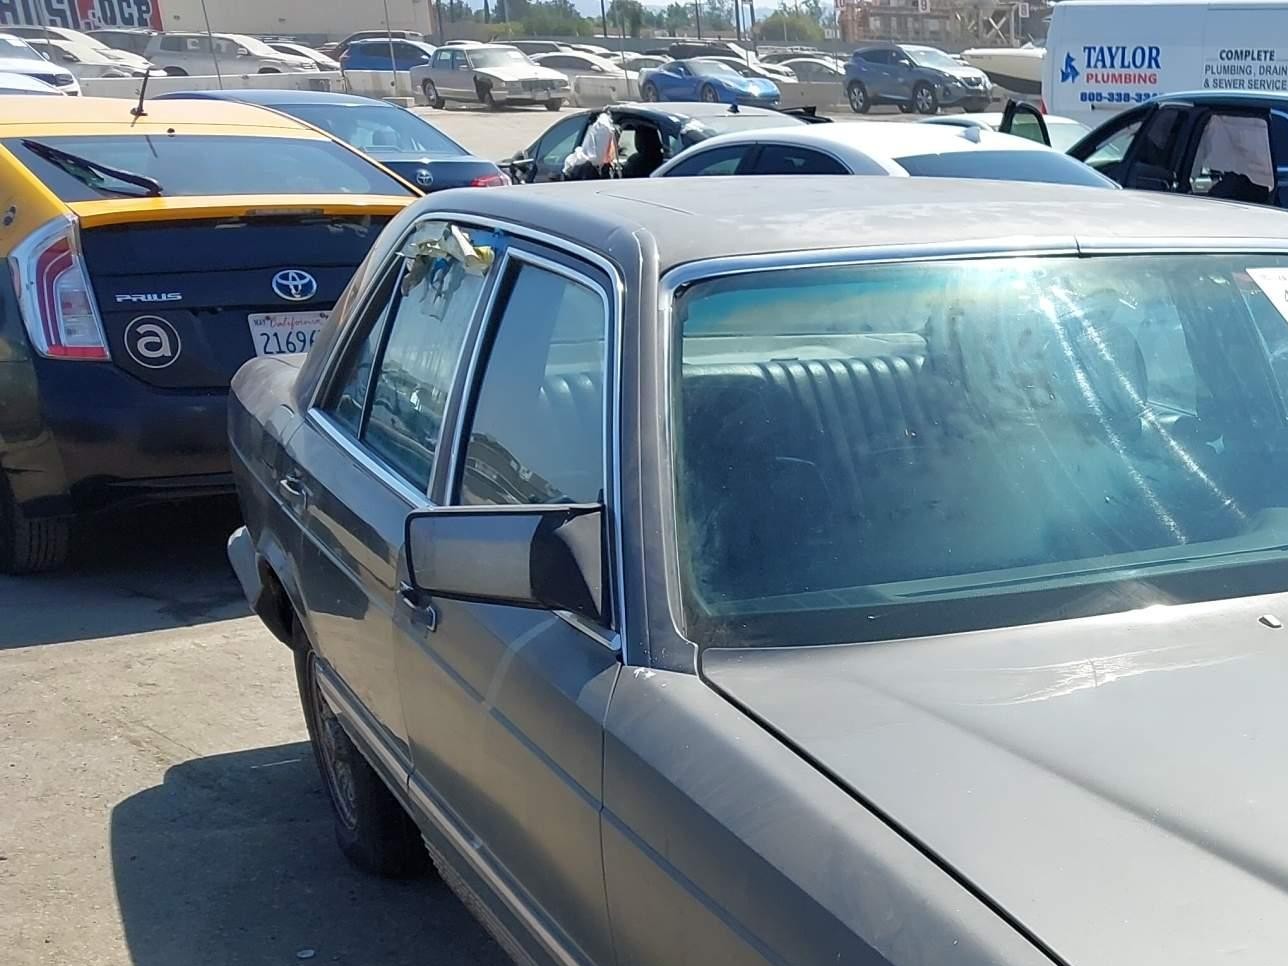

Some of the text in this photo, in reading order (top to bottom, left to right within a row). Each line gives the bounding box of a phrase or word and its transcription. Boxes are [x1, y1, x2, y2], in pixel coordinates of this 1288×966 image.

[1083, 46, 1161, 70] TAYLOR
[1219, 49, 1275, 61] COMPLETE
[1259, 65, 1288, 76] DRAIN
[1086, 73, 1157, 84] PLUMBING
[1203, 78, 1288, 90] & SEWER SERVICE
[115, 293, 182, 302] PRIUS
